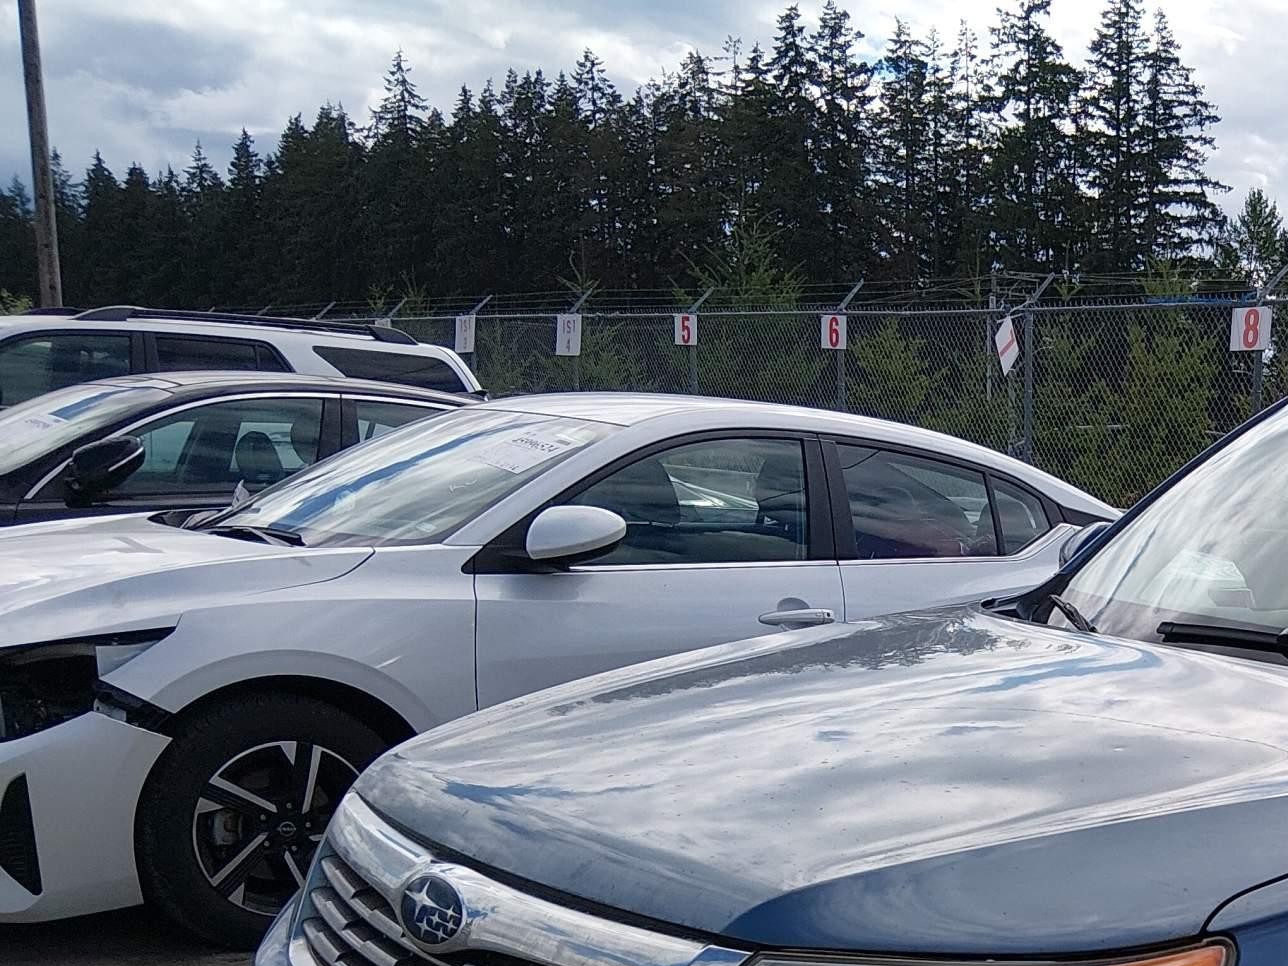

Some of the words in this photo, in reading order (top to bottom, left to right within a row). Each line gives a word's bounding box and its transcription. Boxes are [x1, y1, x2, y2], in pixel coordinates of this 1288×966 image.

[681, 316, 691, 344] 5
[828, 316, 839, 347] 6
[1242, 308, 1260, 349] 8
